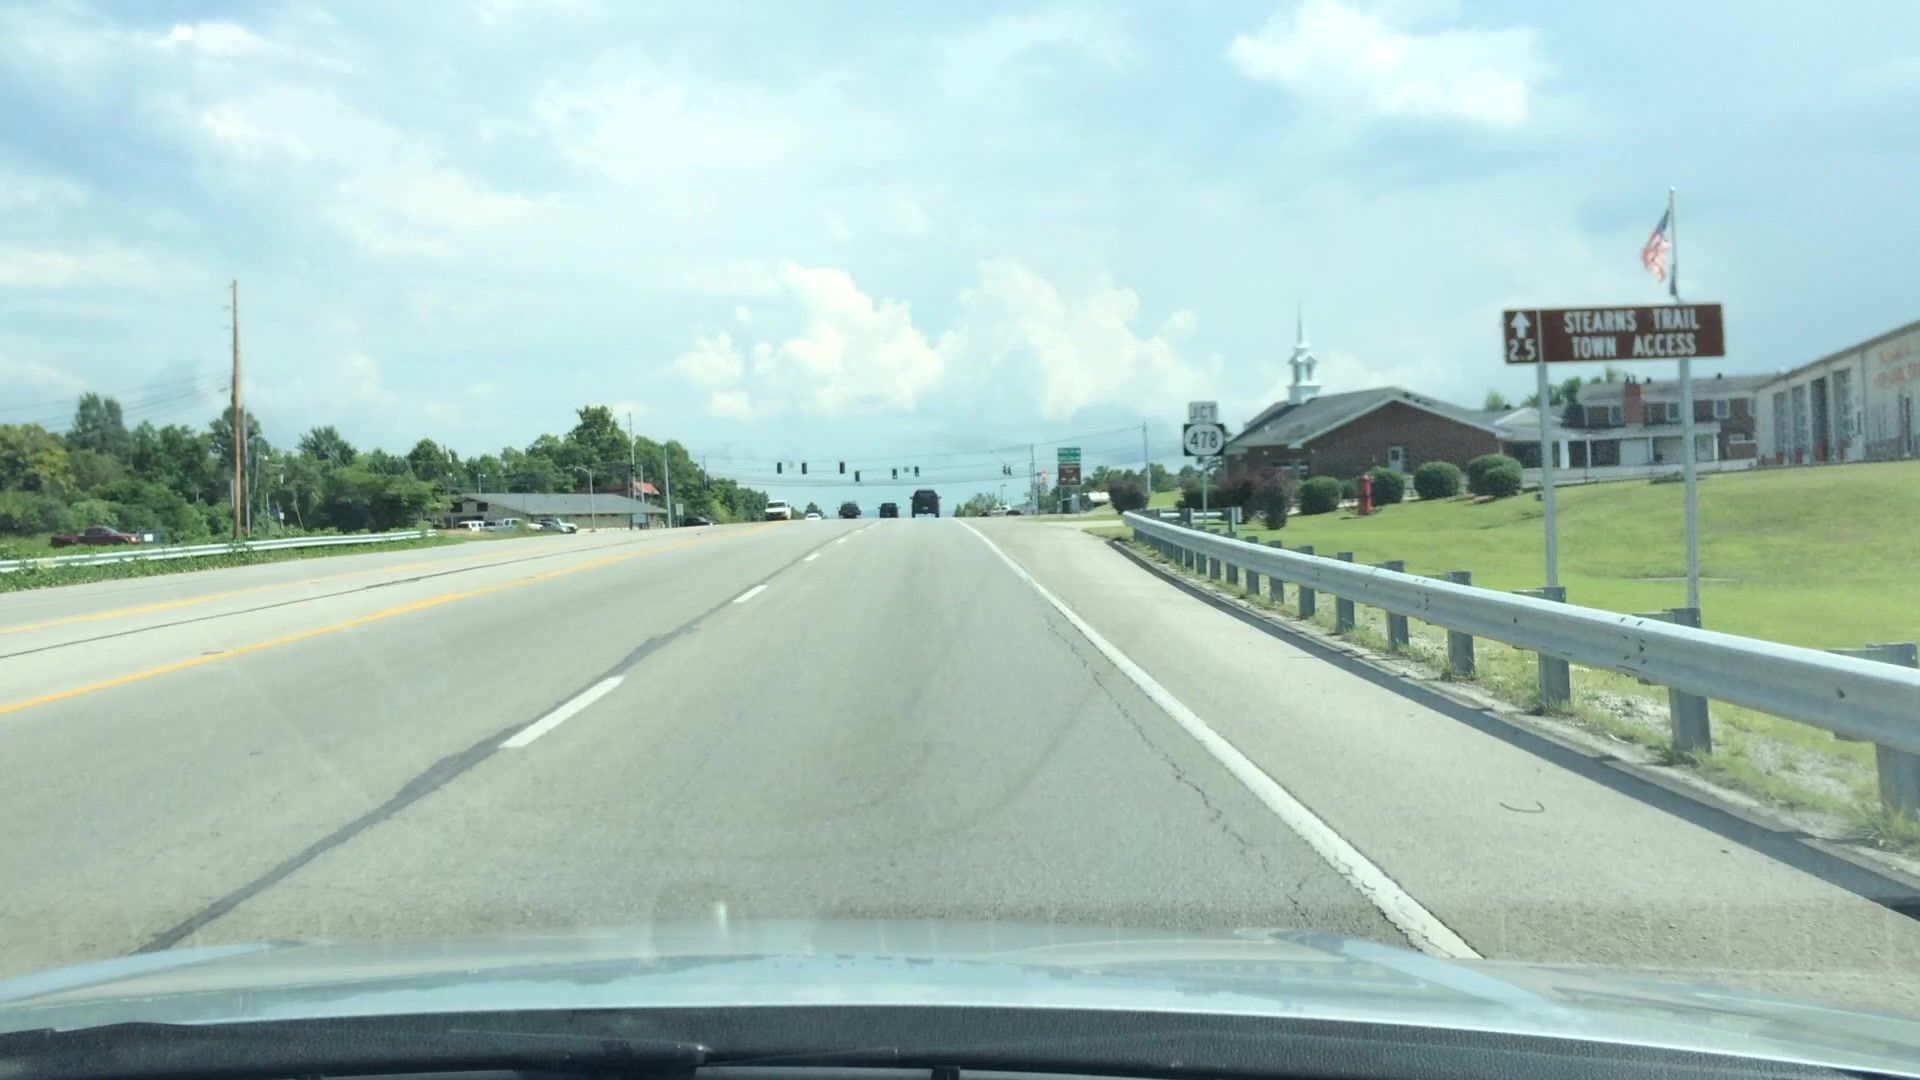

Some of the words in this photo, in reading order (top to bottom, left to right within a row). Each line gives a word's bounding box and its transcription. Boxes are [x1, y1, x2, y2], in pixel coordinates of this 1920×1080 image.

[1563, 309, 1637, 333] STEARNS
[1652, 307, 1700, 330] TRAIL
[1571, 335, 1617, 358] TOWN
[1631, 332, 1697, 356] ACCESS
[1189, 405, 1217, 420] JCT
[1189, 431, 1217, 449] 478
